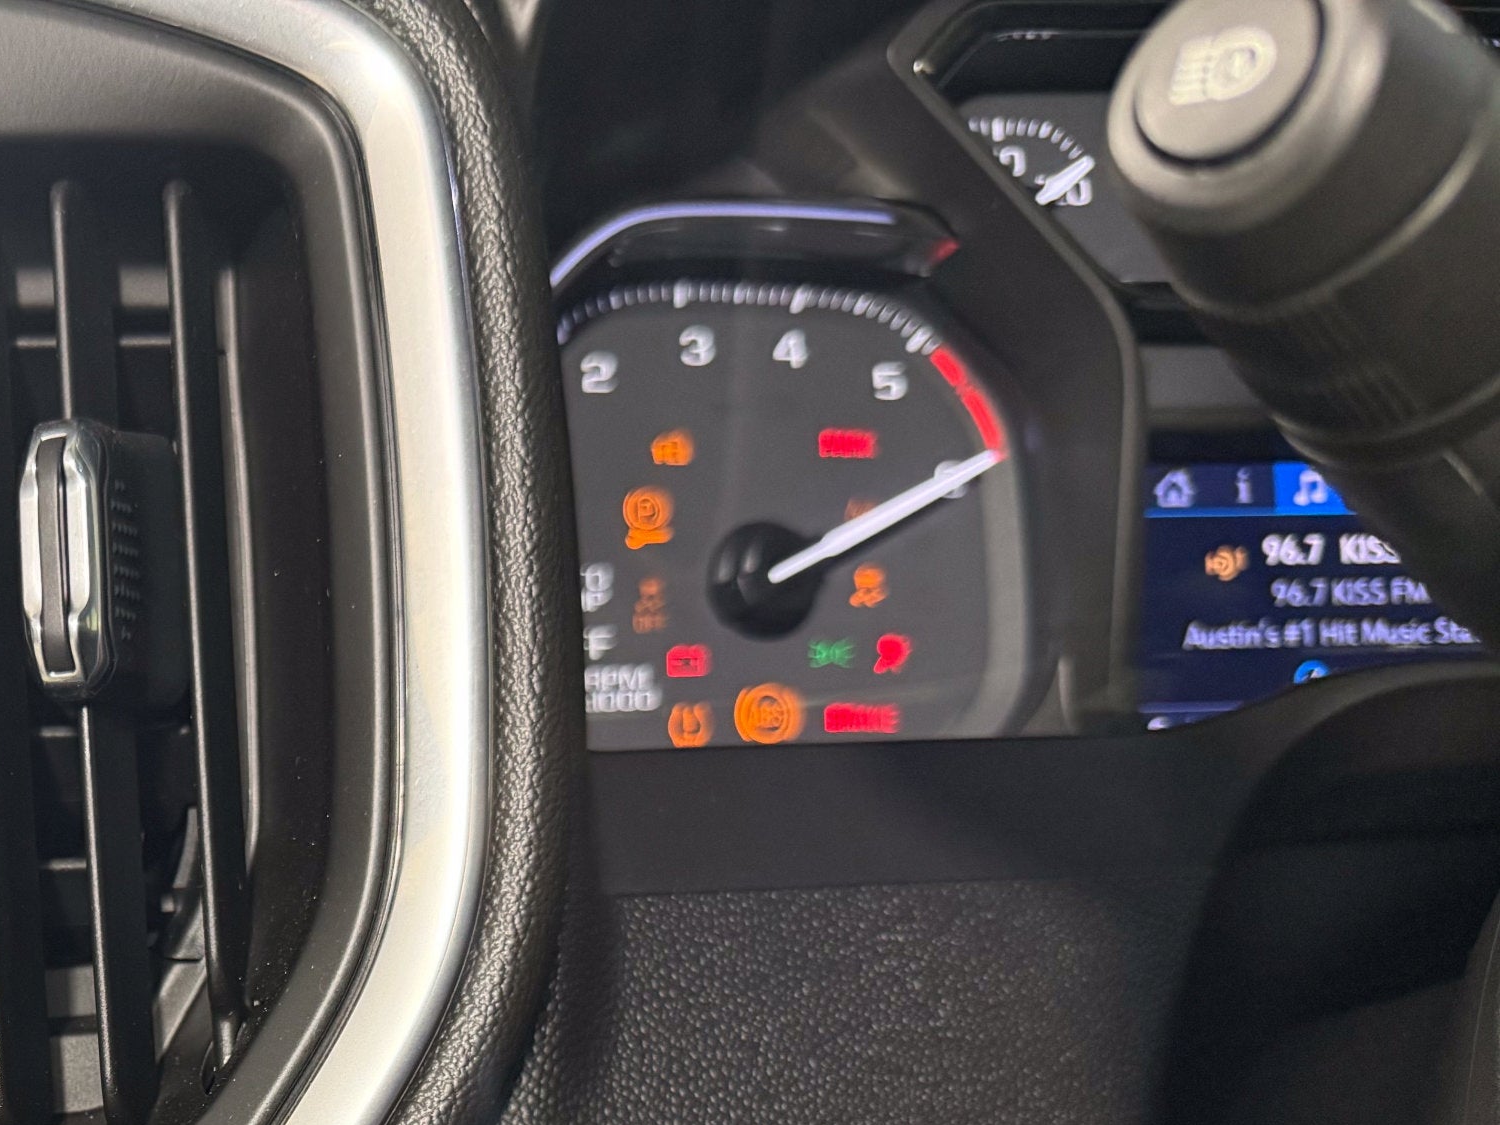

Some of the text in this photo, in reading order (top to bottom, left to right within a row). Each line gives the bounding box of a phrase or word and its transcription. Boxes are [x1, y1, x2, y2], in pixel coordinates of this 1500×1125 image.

[678, 324, 717, 367] 3
[772, 328, 810, 370] 4
[580, 350, 619, 394] 2
[871, 360, 909, 401] 5
[1261, 532, 1326, 566] 96.7
[1270, 576, 1330, 607] 96.7
[1331, 575, 1389, 606] KISS
[1182, 615, 1283, 650] Austin's
[1318, 617, 1360, 647] Hit
[1360, 616, 1433, 646] Music
[1432, 615, 1482, 645] Sta
